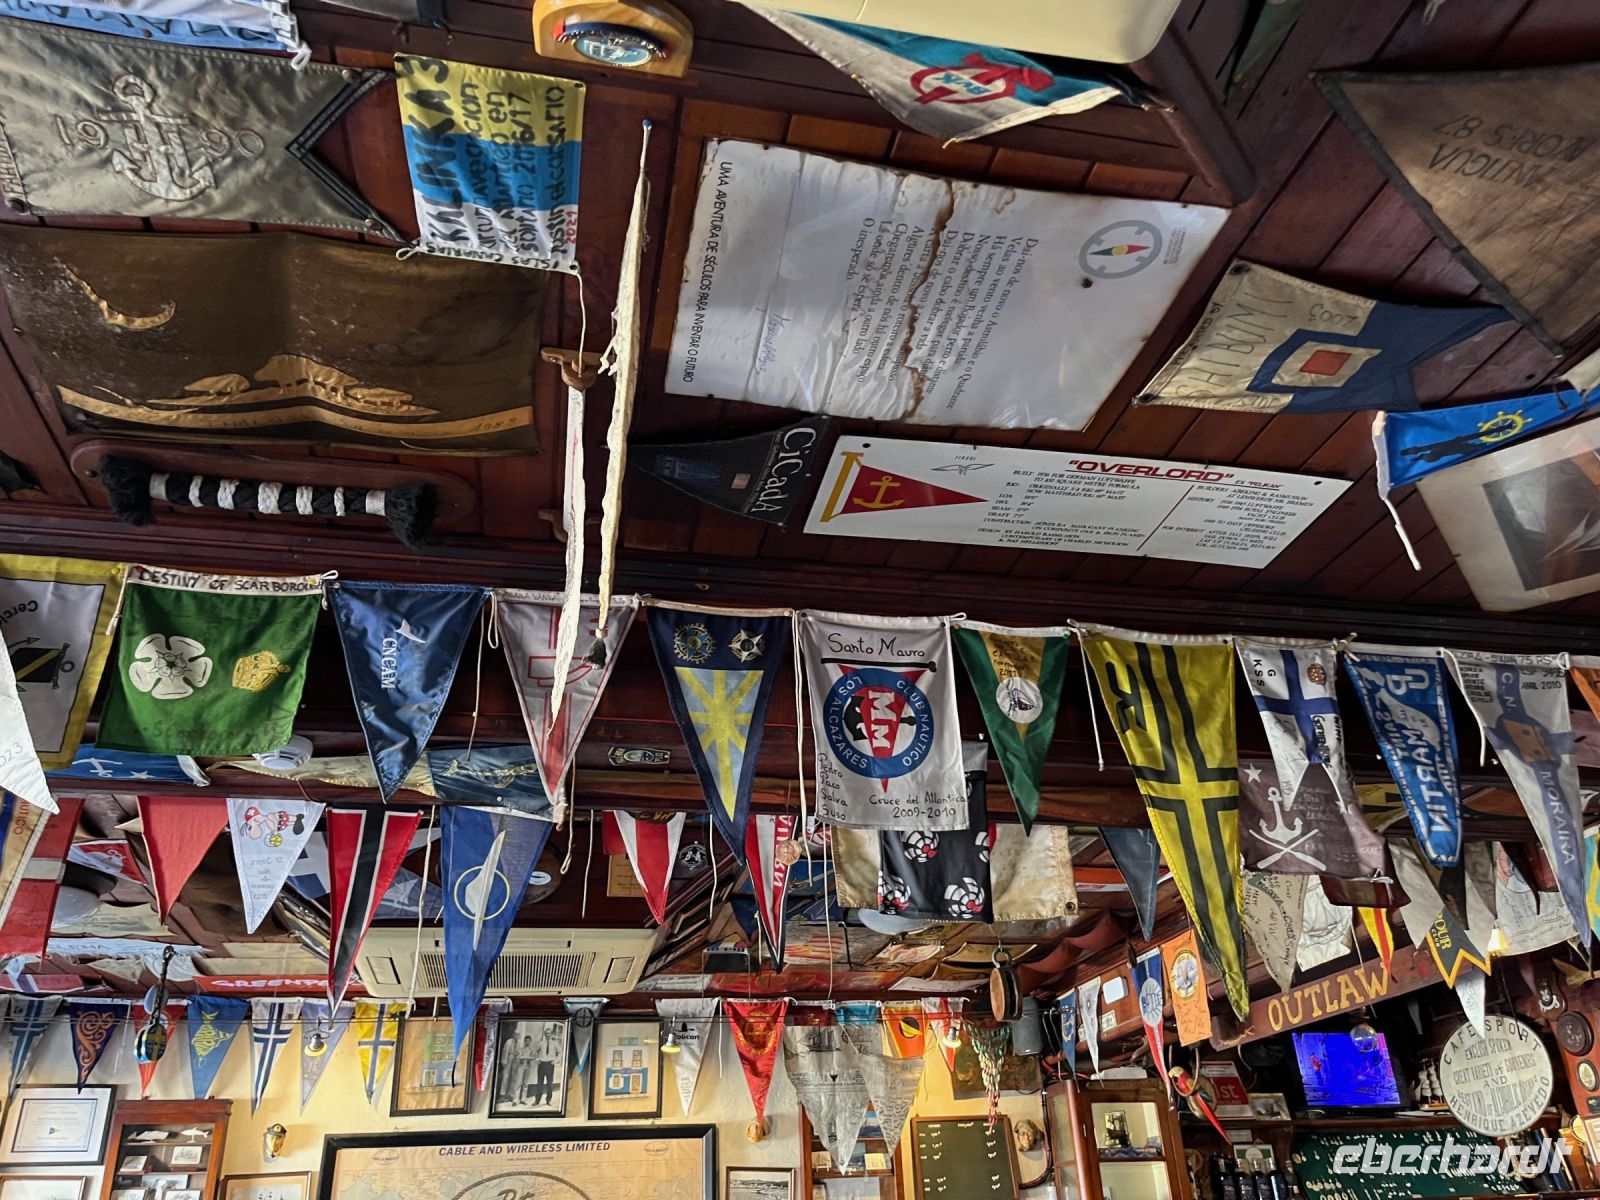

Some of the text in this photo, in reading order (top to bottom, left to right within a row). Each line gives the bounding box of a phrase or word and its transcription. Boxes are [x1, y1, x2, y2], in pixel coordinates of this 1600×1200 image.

[54, 112, 267, 158] 19 90
[716, 160, 732, 186] UMA
[564, 209, 578, 244] 2021
[707, 189, 727, 239] AVENTURA
[425, 241, 561, 271] ISLAS CANARIAS
[705, 240, 718, 253] DE
[699, 254, 718, 291] SÉCULOS
[694, 291, 709, 312] PARA
[688, 312, 704, 348] INVENTAR
[682, 356, 696, 383] FUTURO
[139, 570, 200, 588] DESTINY
[208, 579, 228, 590] OF
[828, 633, 925, 657] Santo Mauro
[828, 696, 868, 769] ALCAZARES
[896, 680, 929, 767] CLUB NAUTICO
[868, 793, 900, 806] Cruce
[211, 978, 330, 990] GREENPE
[1268, 961, 1391, 1032] OUTLAW
[1444, 1019, 1542, 1066] CAFE SPORT
[1484, 1075, 1508, 1089] AND
[1450, 1095, 1507, 1132] HENRIQUE
[1511, 1075, 1550, 1128] AZEVEDO
[439, 1141, 611, 1157] CABLE AND WIRELESS LIMITED
